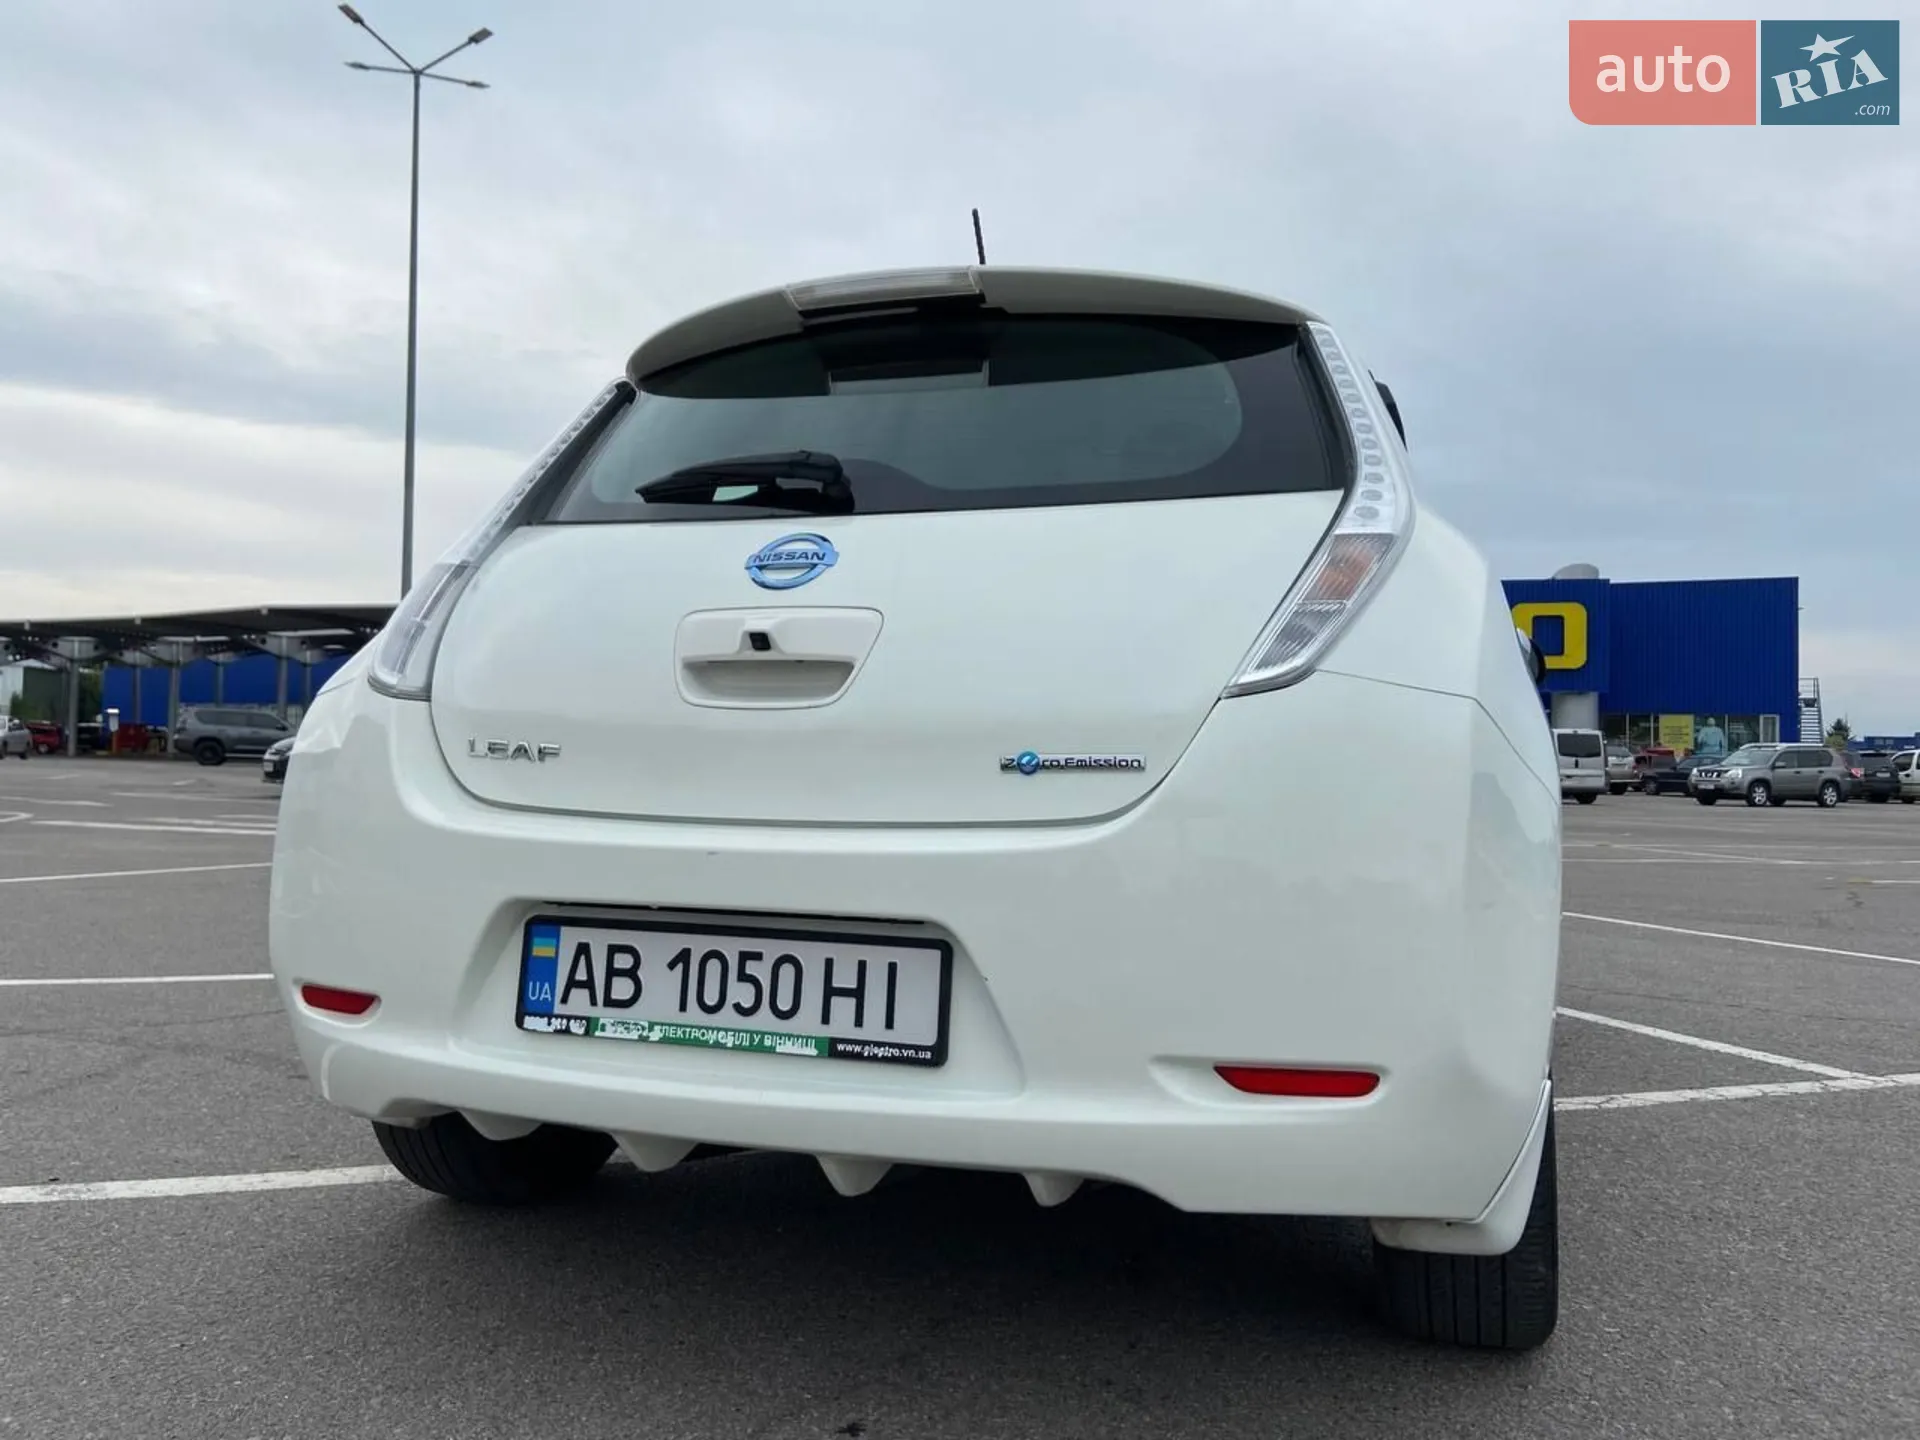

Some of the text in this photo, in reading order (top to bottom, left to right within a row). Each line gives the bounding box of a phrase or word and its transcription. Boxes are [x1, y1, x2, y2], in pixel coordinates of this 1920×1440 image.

[753, 551, 826, 563] NISSAN
[467, 737, 561, 762] LEAF
[528, 981, 552, 1002] UA
[560, 941, 643, 1009] AB
[666, 947, 804, 1021] 1050
